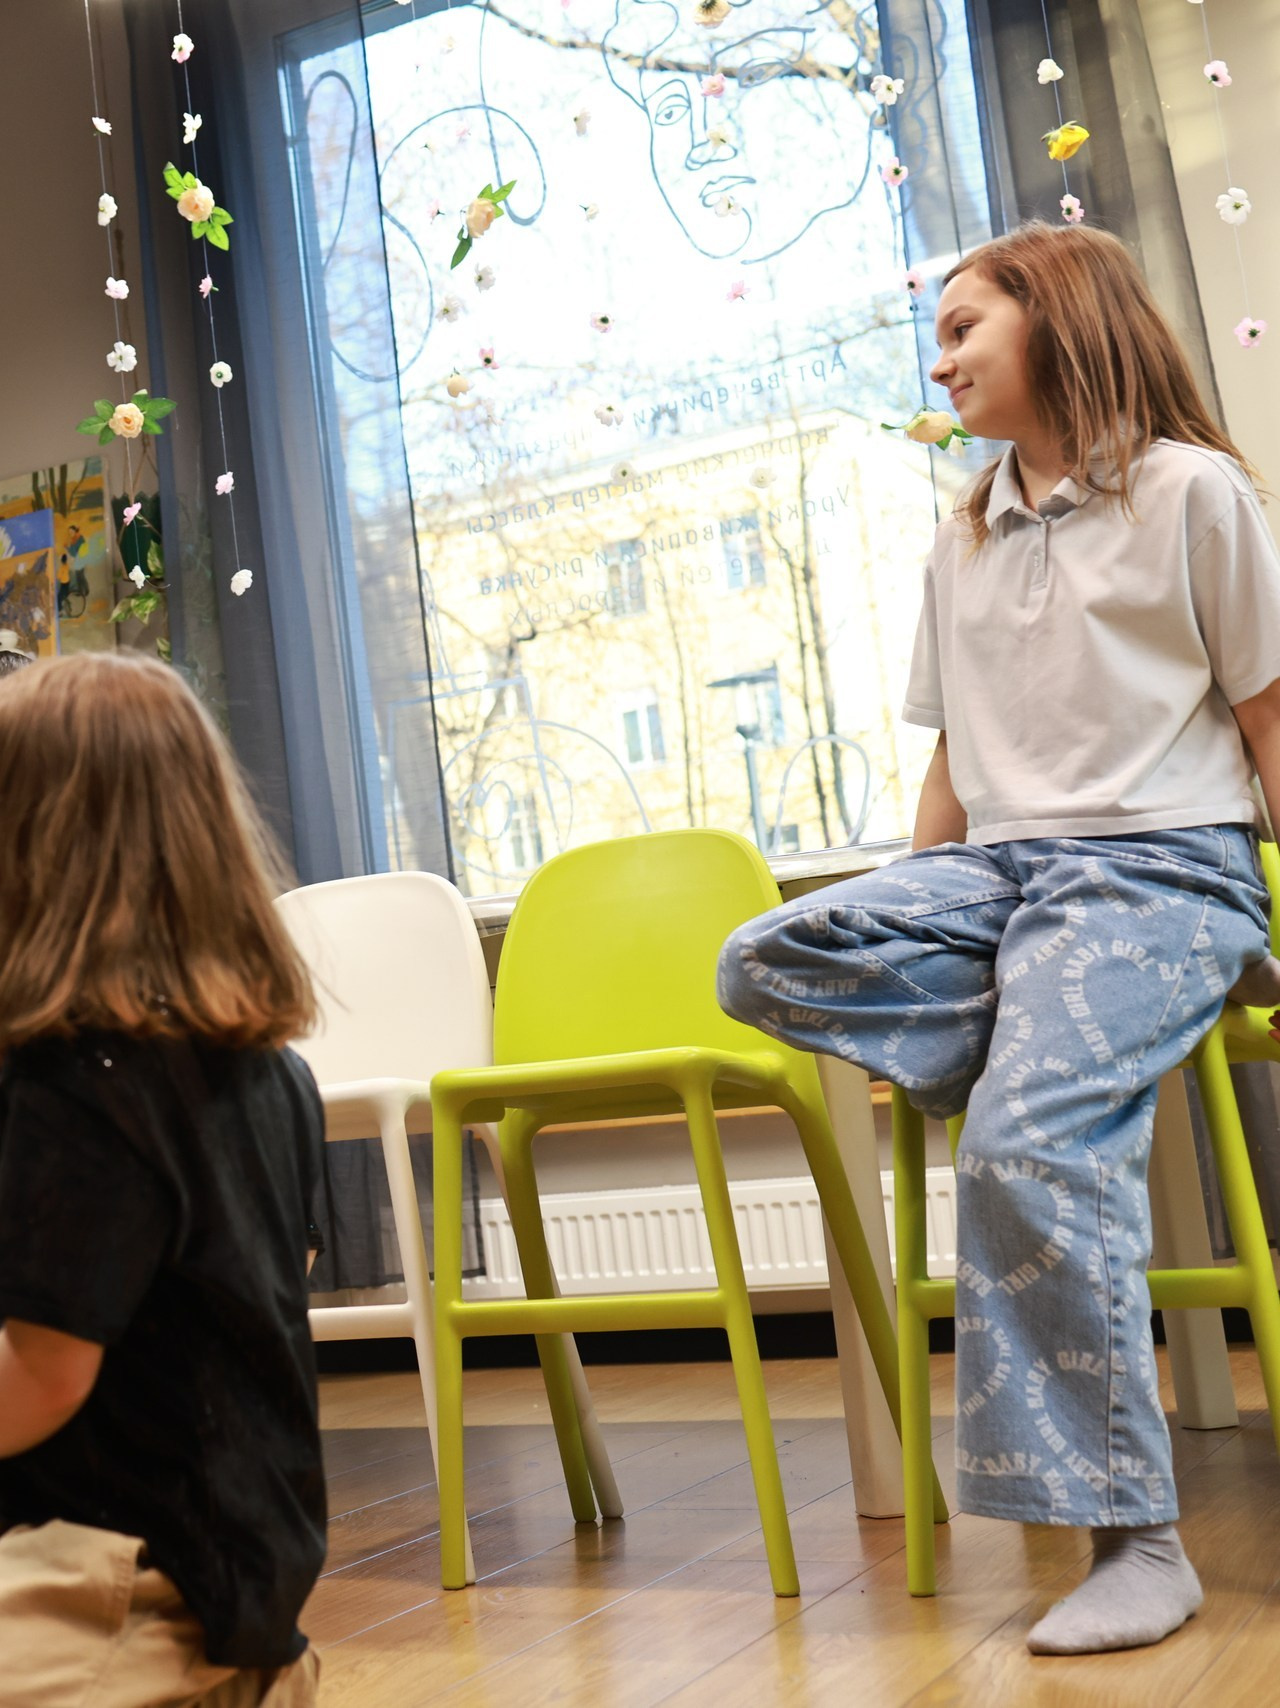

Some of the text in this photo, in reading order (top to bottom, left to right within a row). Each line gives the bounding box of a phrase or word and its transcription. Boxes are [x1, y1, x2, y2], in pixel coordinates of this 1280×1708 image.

[1032, 928, 1077, 966] BABY
[1061, 940, 1106, 979] BABY
[1110, 939, 1156, 973] GIRL
[1003, 961, 1030, 985] GIR
[1061, 983, 1092, 1019] GIRL
[1076, 1022, 1114, 1065] BABY
[989, 1159, 1052, 1183] BABY
[996, 1262, 1041, 1297] GIRL
[1056, 1350, 1108, 1377] GIRL
[1024, 1357, 1053, 1410] BABY
[1034, 1412, 1068, 1454] GIRL
[982, 1452, 1043, 1476] BABY
[1041, 1467, 1071, 1513] GIRL
[1062, 1451, 1110, 1493] BABY
